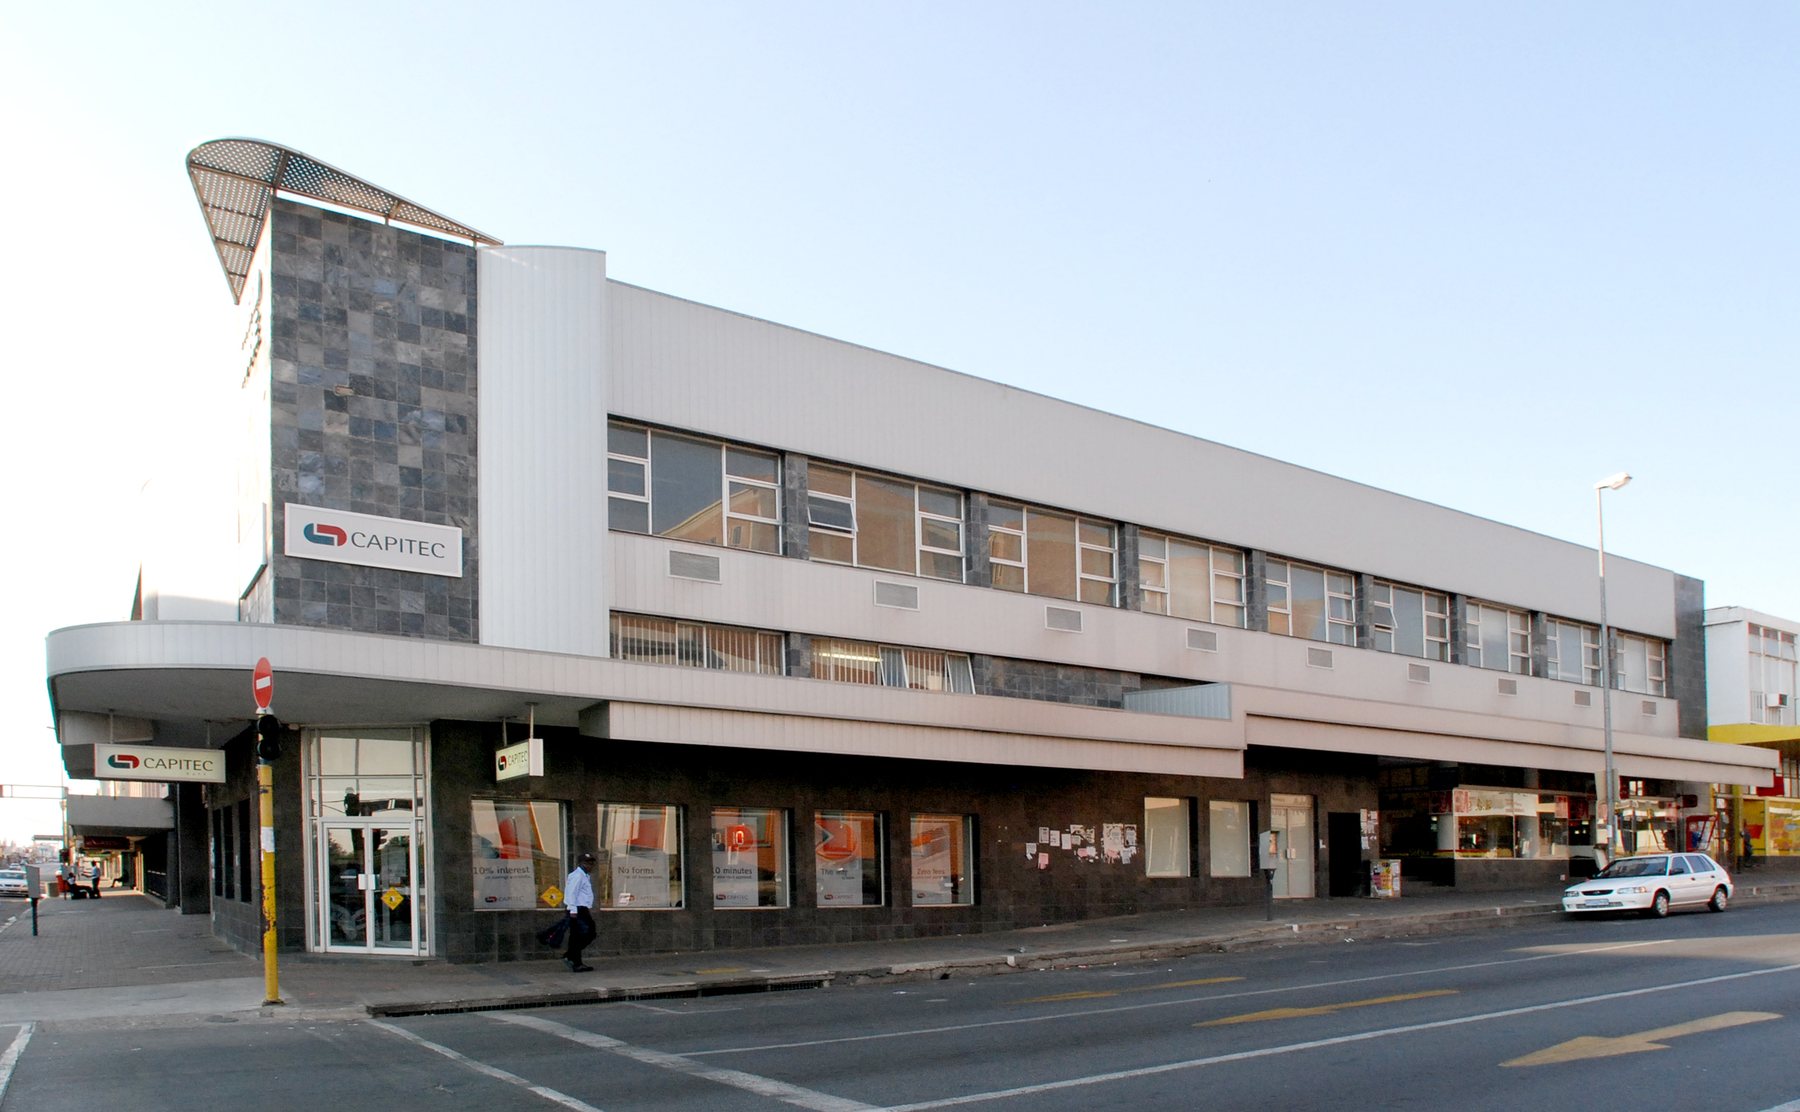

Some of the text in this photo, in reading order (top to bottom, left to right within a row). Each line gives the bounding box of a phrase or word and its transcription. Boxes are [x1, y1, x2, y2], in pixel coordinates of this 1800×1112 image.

[351, 531, 446, 559] CAPITEC
[143, 757, 213, 771] CAPITEC
[508, 750, 528, 766] CAPITEC
[472, 865, 531, 875] 10% interest
[618, 866, 655, 875] No forms
[723, 867, 753, 875] minutes
